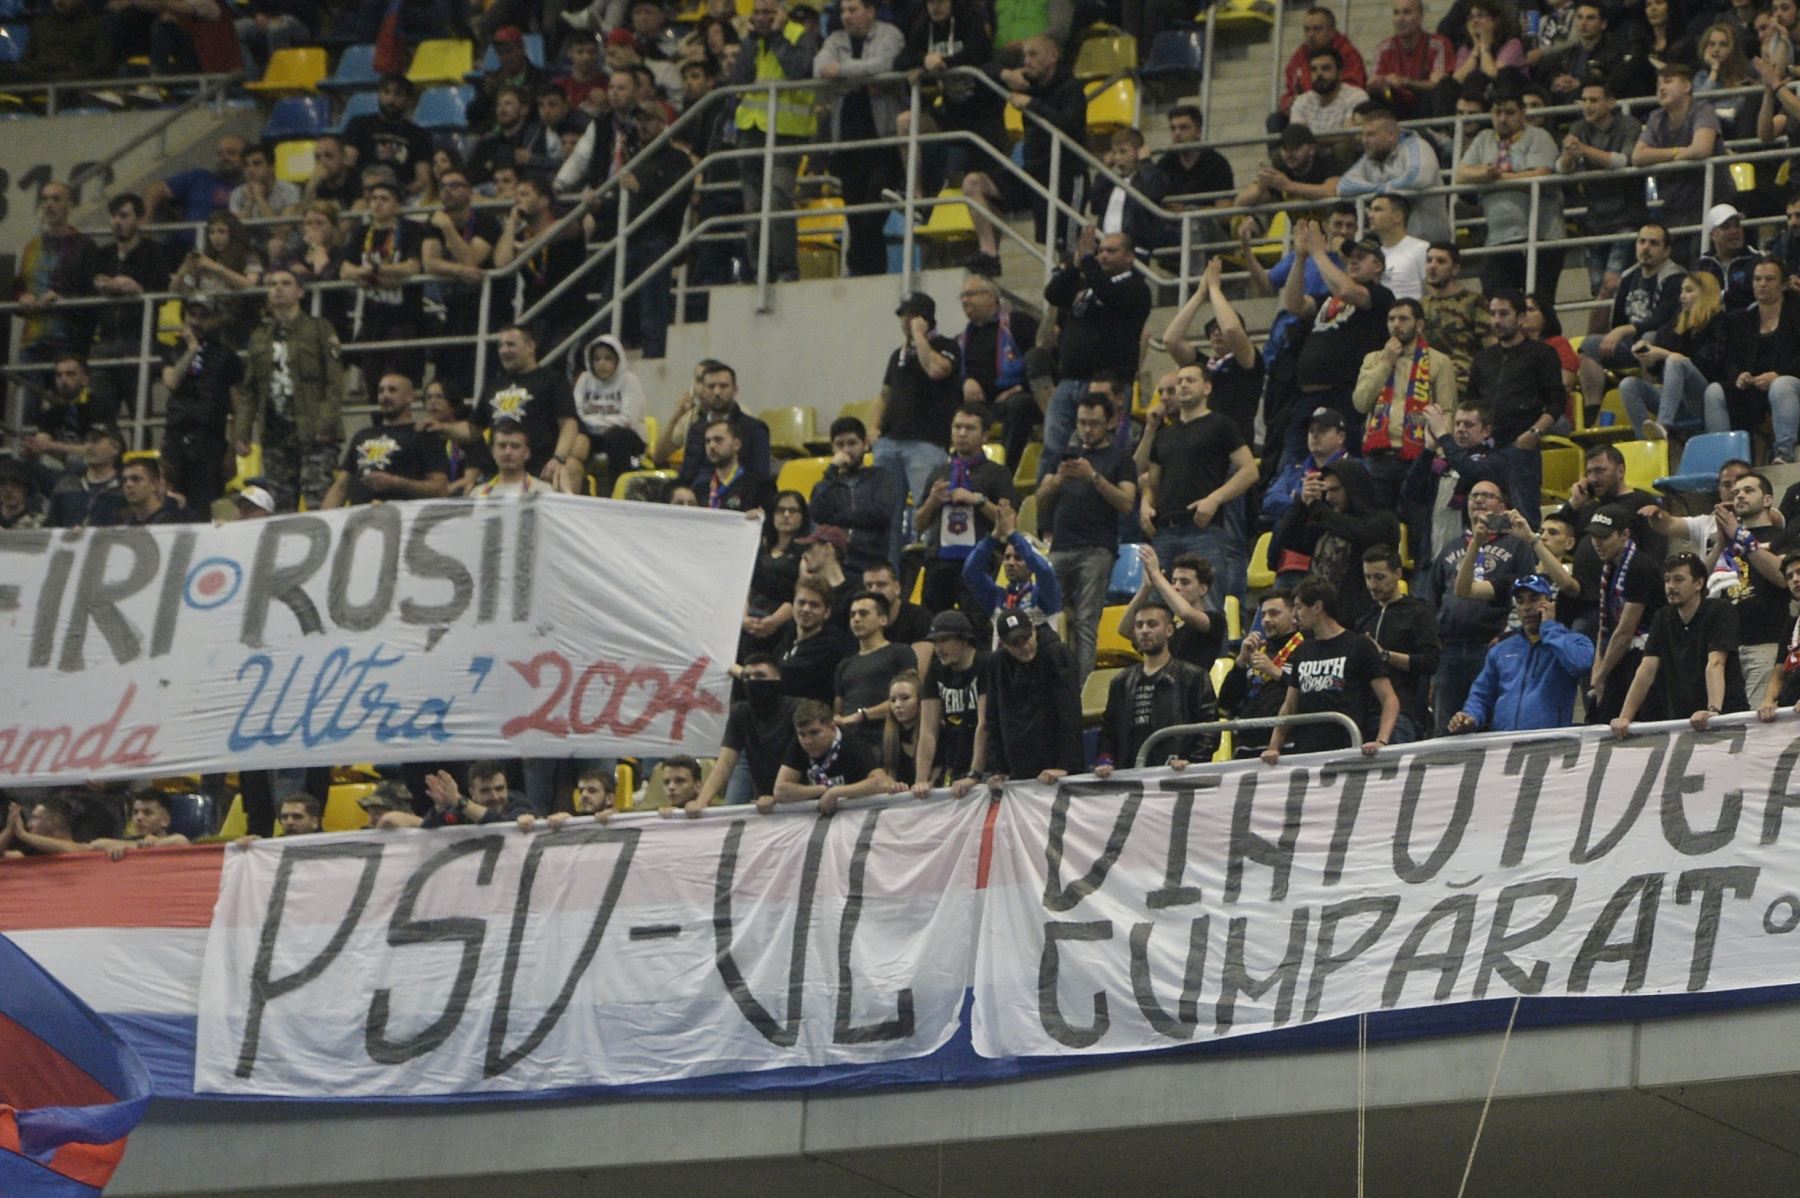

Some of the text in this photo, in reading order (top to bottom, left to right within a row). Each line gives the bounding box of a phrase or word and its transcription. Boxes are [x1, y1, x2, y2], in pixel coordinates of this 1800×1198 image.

[500, 651, 726, 742] 2004
[1298, 656, 1347, 682] SOUTH
[1301, 675, 1333, 693] Boys
[1038, 862, 1761, 1049] CUMPĂRAT
